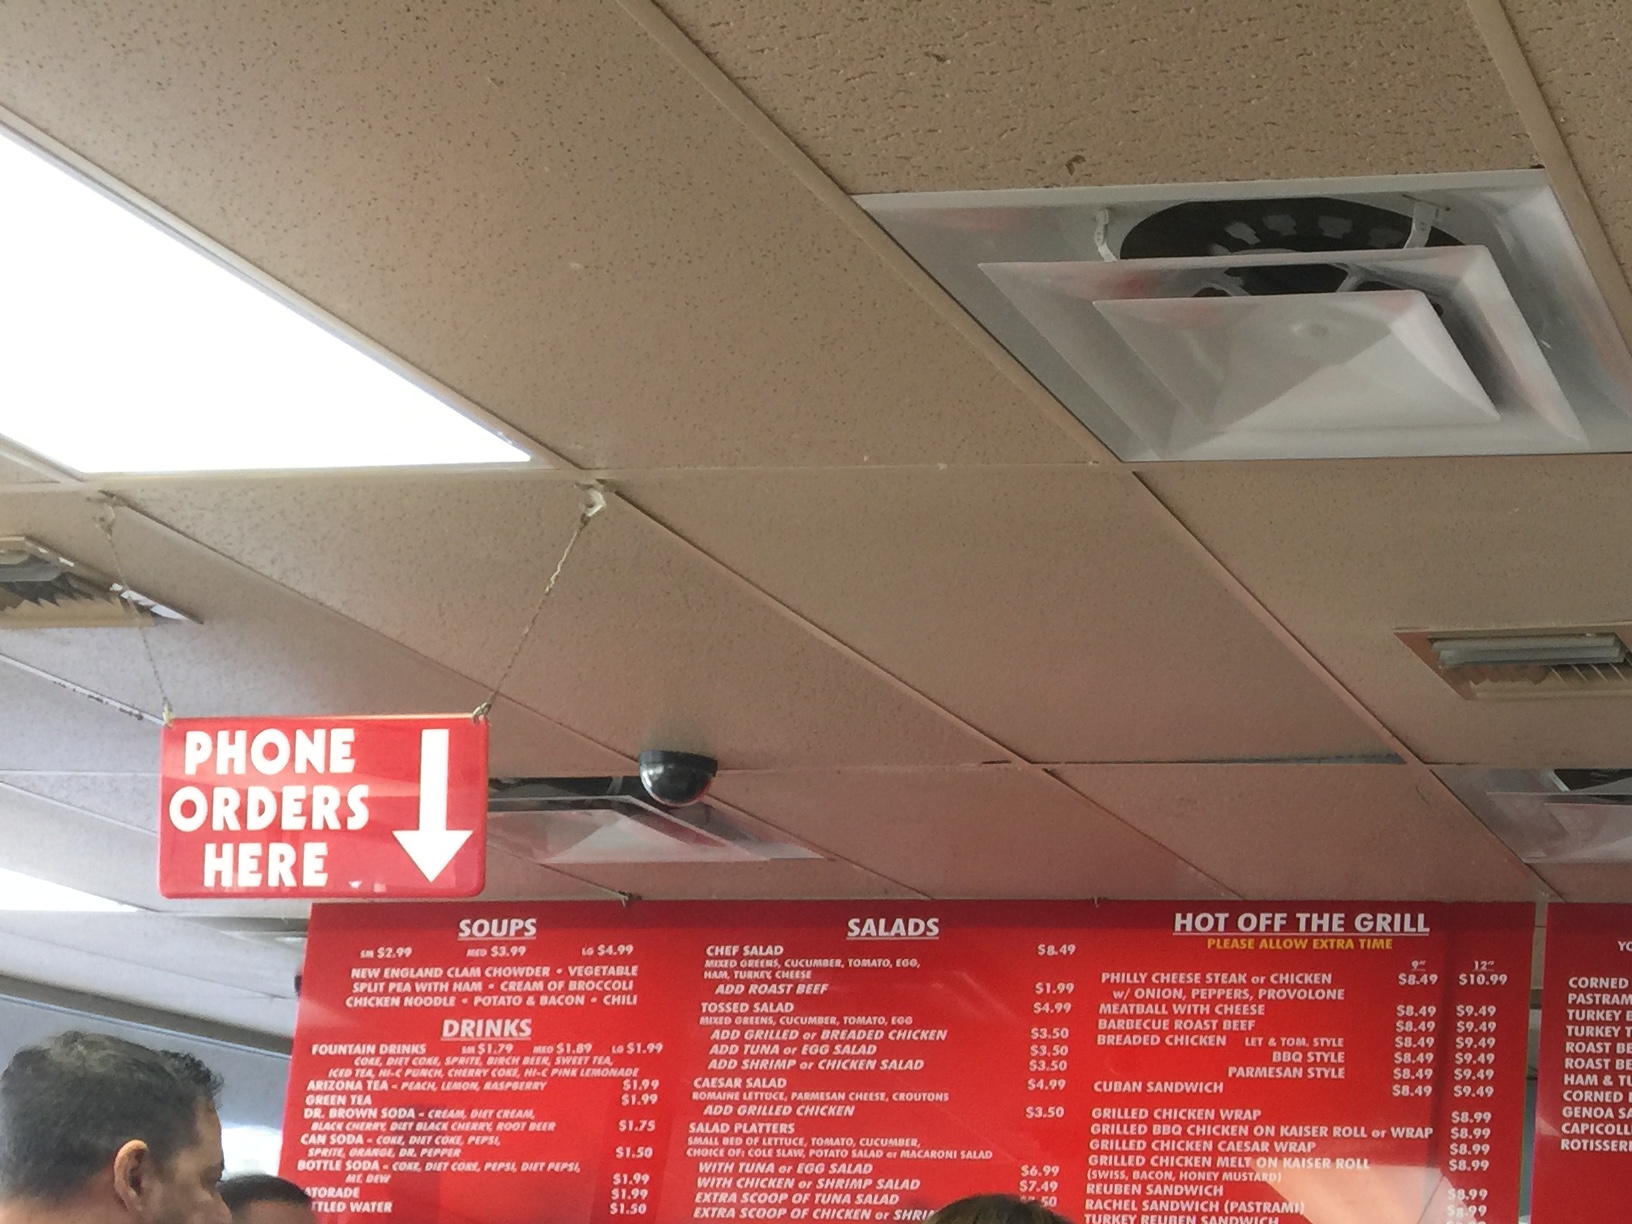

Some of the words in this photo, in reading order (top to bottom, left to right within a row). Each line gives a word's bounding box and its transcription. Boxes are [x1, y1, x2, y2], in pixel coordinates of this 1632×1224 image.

[184, 727, 355, 775] PHONE
[169, 785, 369, 832] ORDERS
[203, 842, 328, 887] HERE
[458, 918, 536, 938] SOUPS
[848, 918, 938, 938] SALADS
[1175, 913, 1228, 934] HOT
[1238, 913, 1286, 934] OFF
[1296, 913, 1344, 934] THE
[1354, 913, 1429, 934] GRILL
[1208, 938, 1254, 948] PLEASE
[1259, 938, 1308, 948] ALLOW
[1312, 938, 1354, 948] EXTRA
[1359, 938, 1392, 948] TIME
[706, 945, 738, 956] CHEF
[743, 945, 783, 955] SALAD
[1038, 944, 1075, 955] $8.49
[351, 968, 380, 978] NEW
[383, 967, 442, 978] ENGLAND
[446, 967, 480, 977] CLAM
[484, 966, 550, 977] CHOWDER
[568, 965, 638, 976] VEGETABLE
[1102, 972, 1147, 982] PHILLY
[1151, 972, 1200, 983] CHEESE
[1206, 972, 1246, 983] STEAK
[1270, 973, 1331, 983] CHICKEN
[1398, 973, 1437, 984] $8.49
[1459, 973, 1507, 984] $10.99
[715, 984, 744, 994] ADD
[748, 984, 793, 994] ROAST
[796, 983, 828, 994] BEEF
[1035, 982, 1074, 994] $1.99
[1568, 977, 1628, 988] CORNED
[346, 996, 400, 1007] CHICKEN
[404, 996, 455, 1006] NOODLE
[474, 995, 522, 1006] POTATO
[526, 996, 534, 1005] &
[539, 995, 584, 1005] BACON
[603, 994, 636, 1004] CHILI
[701, 1002, 748, 1012] TOSSED
[753, 1002, 794, 1012] SALAD
[1034, 1002, 1071, 1013] $4.99
[442, 1019, 531, 1038] DRINKS
[1098, 1019, 1169, 1032] BARBECUE
[1174, 1019, 1218, 1030] ROAST
[1222, 1019, 1254, 1030] BEEF
[1566, 1025, 1620, 1037] TURKEY
[710, 1029, 740, 1039] ADD
[744, 1029, 798, 1039] GRILLED
[820, 1029, 884, 1039] BREADED
[888, 1029, 947, 1040] CHICKEN
[1031, 1027, 1068, 1039] $3.50
[1094, 1081, 1142, 1092] CUBAN
[1146, 1081, 1223, 1092] SANDWICH
[1392, 1084, 1432, 1096] $8.49
[1454, 1085, 1493, 1096] $9.49
[305, 1094, 346, 1106] GREEN
[350, 1094, 371, 1106] TEA
[622, 1093, 657, 1105] $1.99
